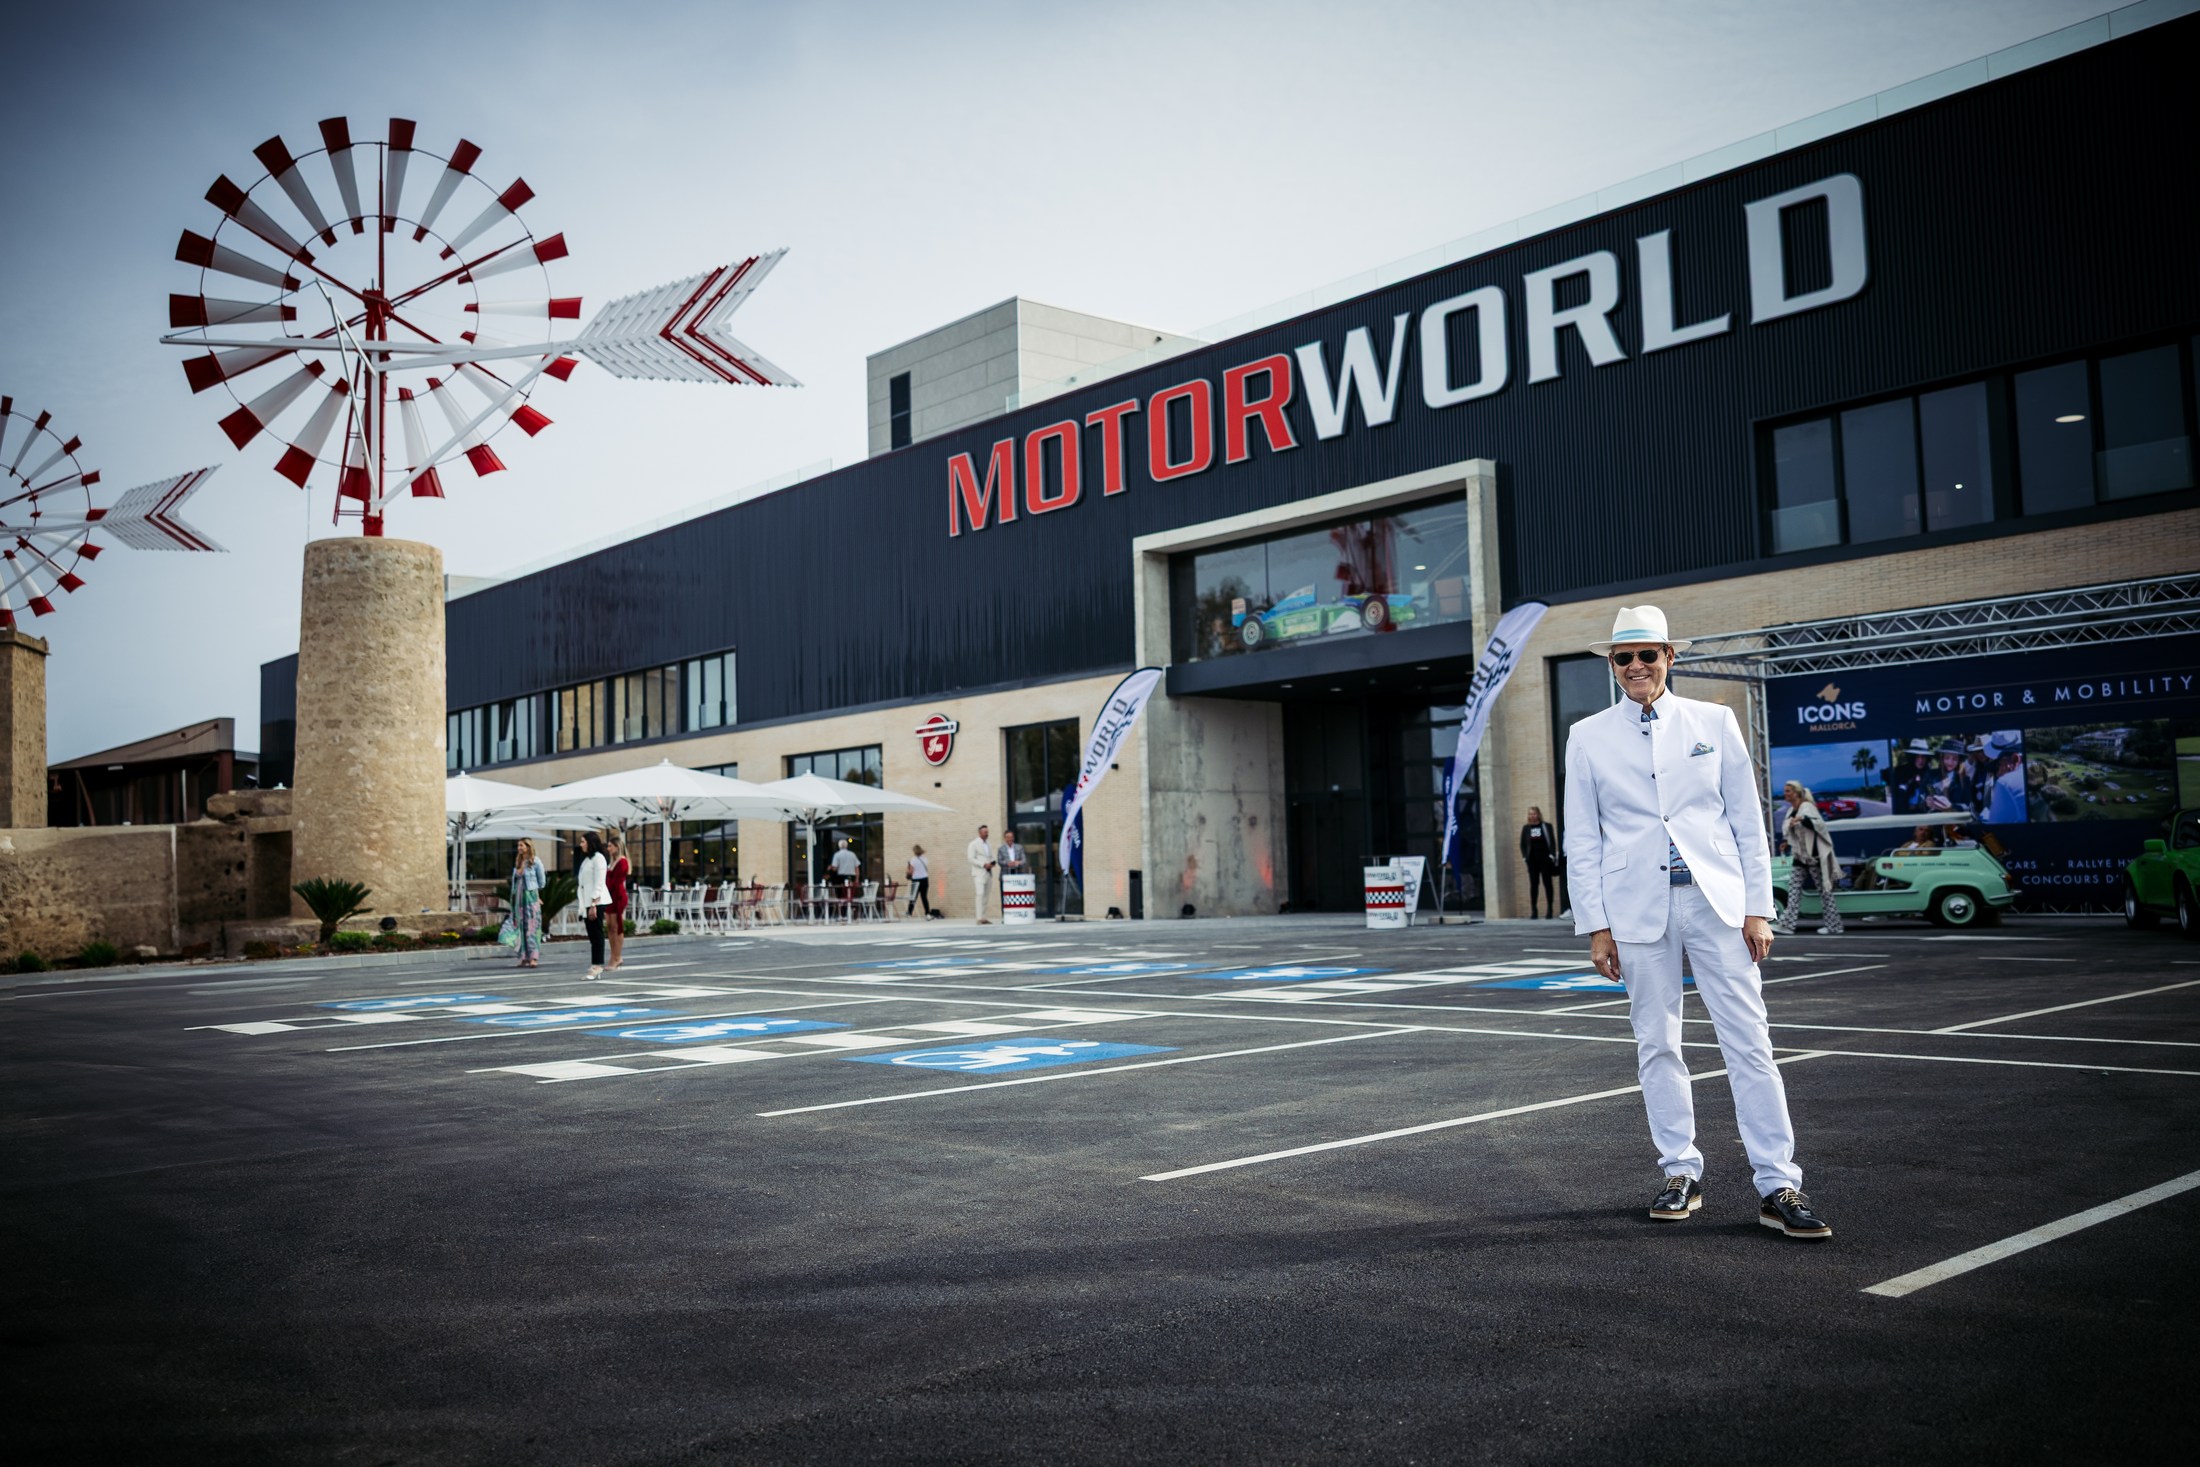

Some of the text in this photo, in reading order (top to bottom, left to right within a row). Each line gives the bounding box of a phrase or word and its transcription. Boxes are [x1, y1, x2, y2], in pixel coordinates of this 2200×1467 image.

[947, 172, 1869, 539] MOTORWORLD
[1916, 675, 2193, 714] MOTOR & MOBILITY
[1797, 701, 1867, 725] ICONS
[1809, 721, 1857, 733] MALLORCA
[2005, 860, 2037, 870] CARS
[2067, 858, 2113, 869] RALLYE
[2022, 874, 2099, 885] CONCOURS
